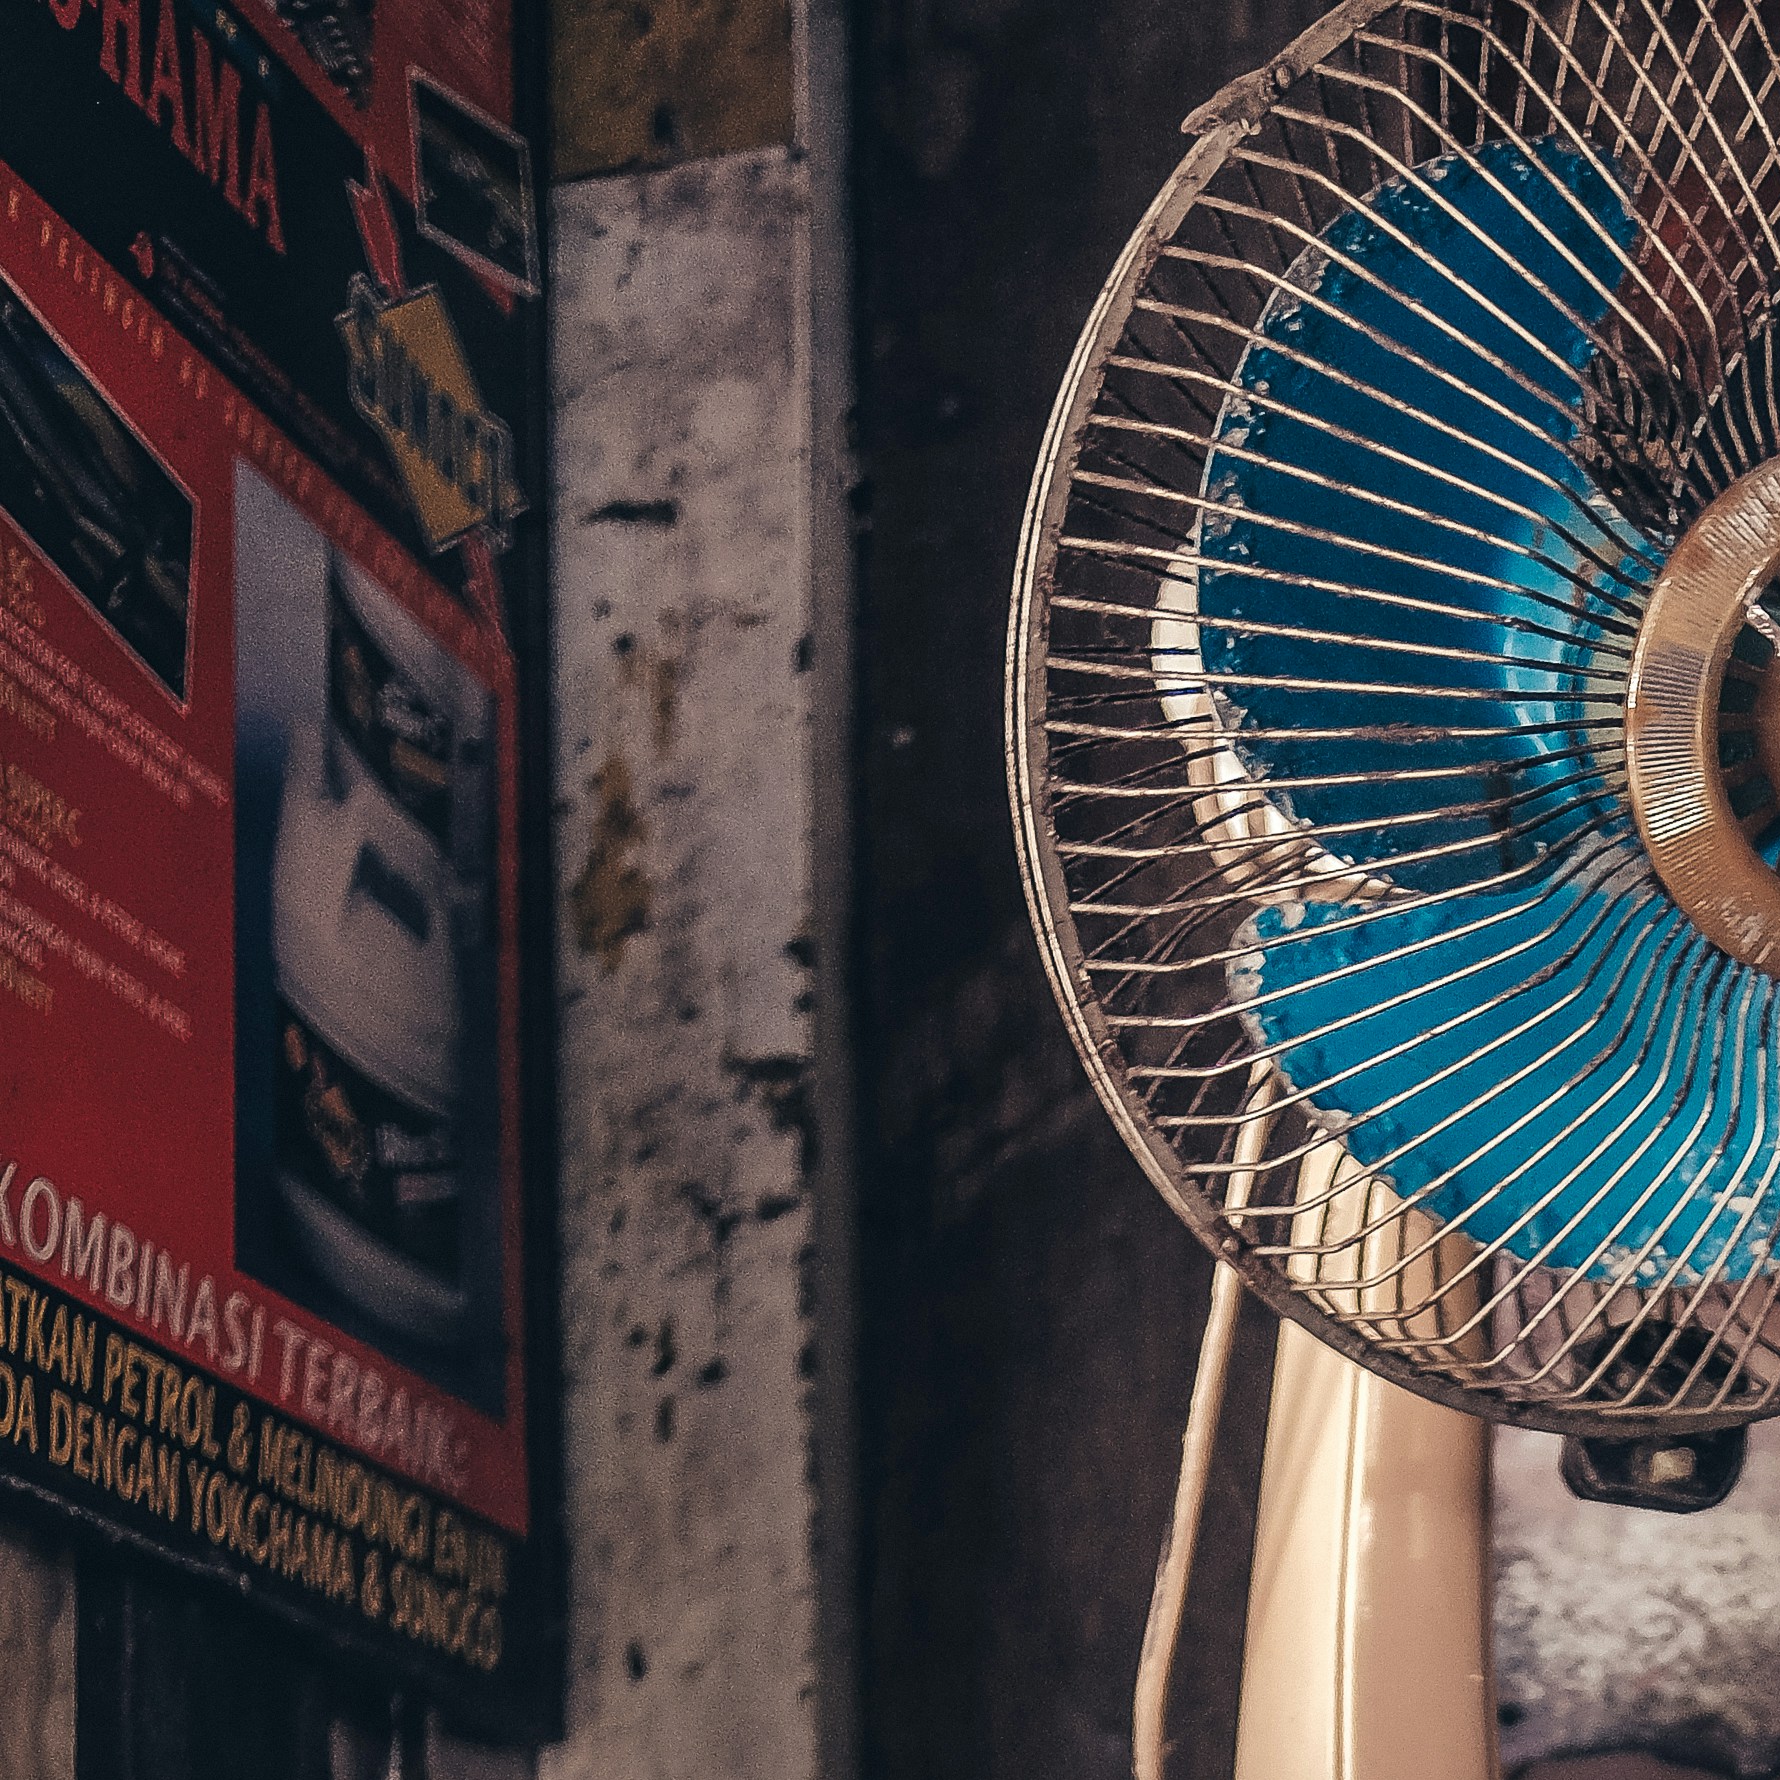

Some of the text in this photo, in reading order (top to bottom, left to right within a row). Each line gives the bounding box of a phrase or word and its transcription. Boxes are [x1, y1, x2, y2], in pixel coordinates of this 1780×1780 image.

[50, 0, 286, 254] HAMA
[0, 1270, 97, 1394] TKAN
[103, 1332, 220, 1461] PETROL
